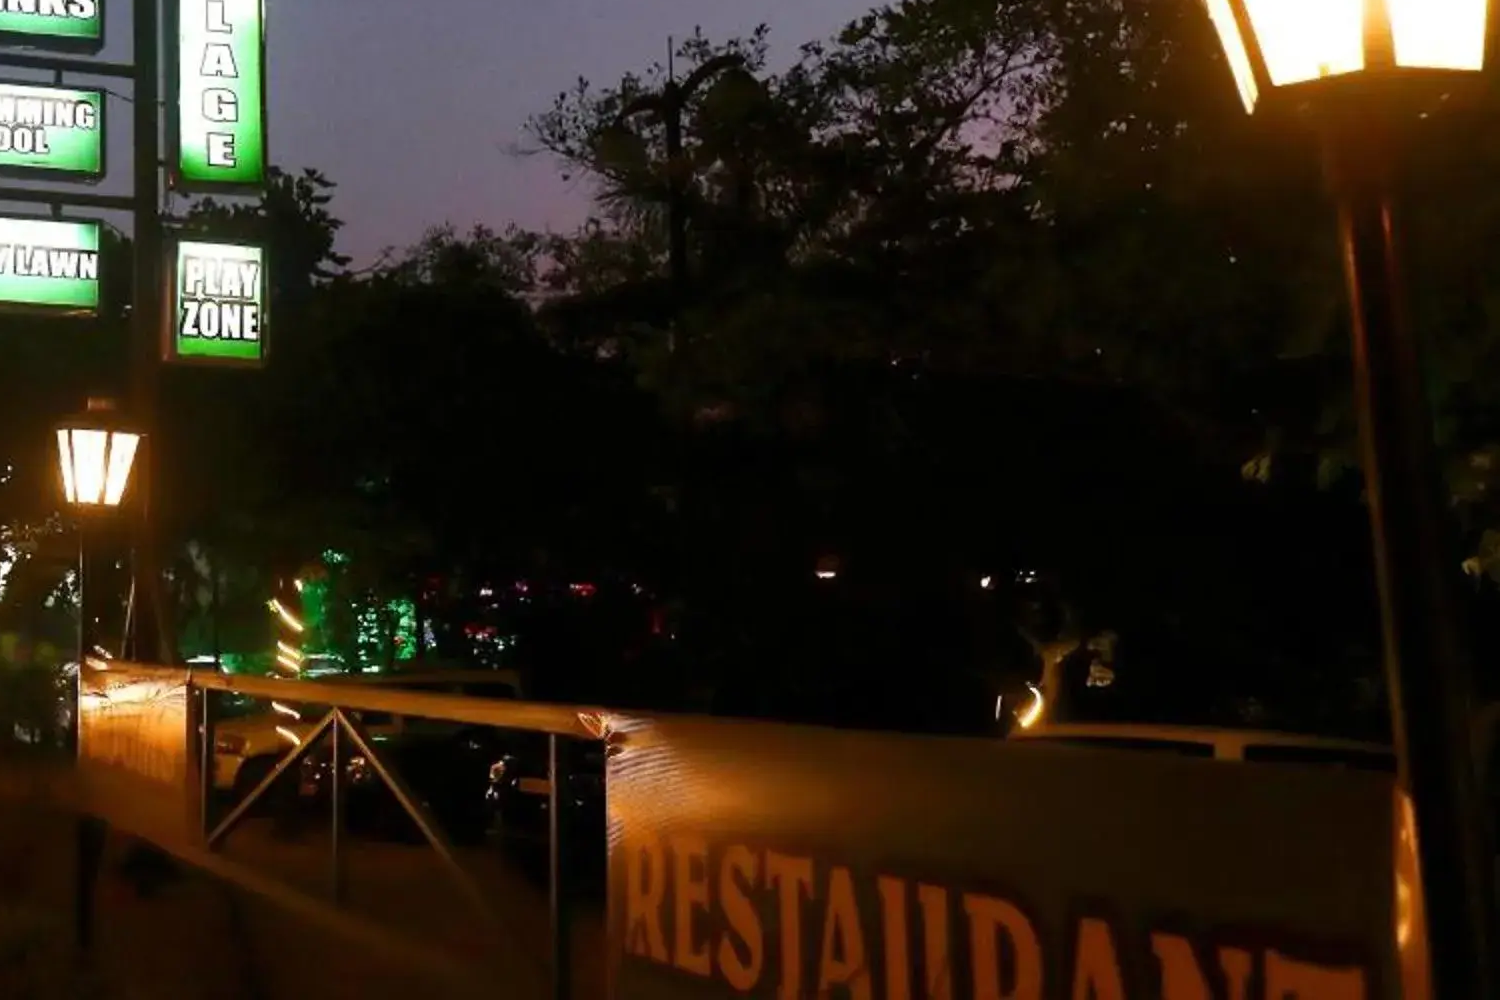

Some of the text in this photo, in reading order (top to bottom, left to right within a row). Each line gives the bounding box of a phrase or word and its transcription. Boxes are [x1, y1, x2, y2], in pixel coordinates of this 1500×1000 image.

[13, 244, 98, 281] LAWN
[184, 255, 260, 298] PLAY
[180, 301, 261, 341] ZONE
